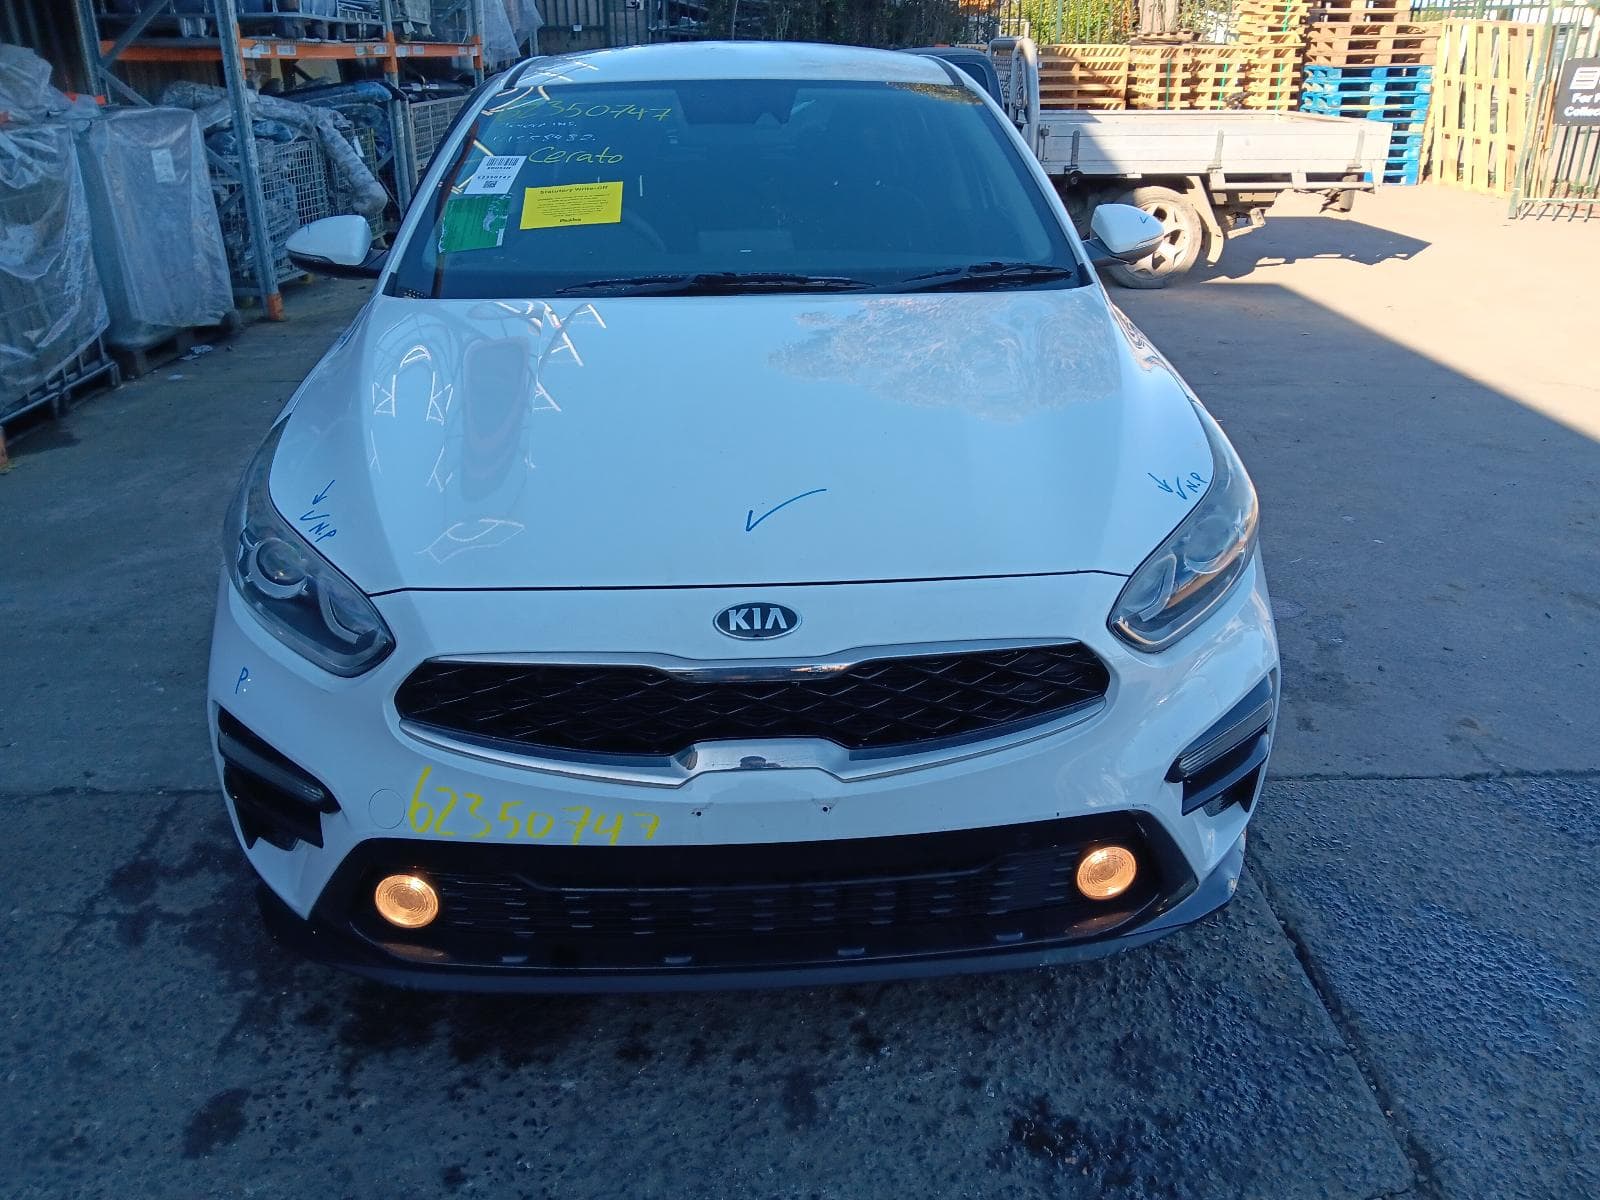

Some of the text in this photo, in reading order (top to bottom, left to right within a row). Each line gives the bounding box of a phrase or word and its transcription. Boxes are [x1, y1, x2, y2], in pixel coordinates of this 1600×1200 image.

[1572, 92, 1594, 103] For
[528, 146, 624, 164] Cerato
[728, 607, 787, 631] KIA
[407, 765, 660, 845] 62350747
